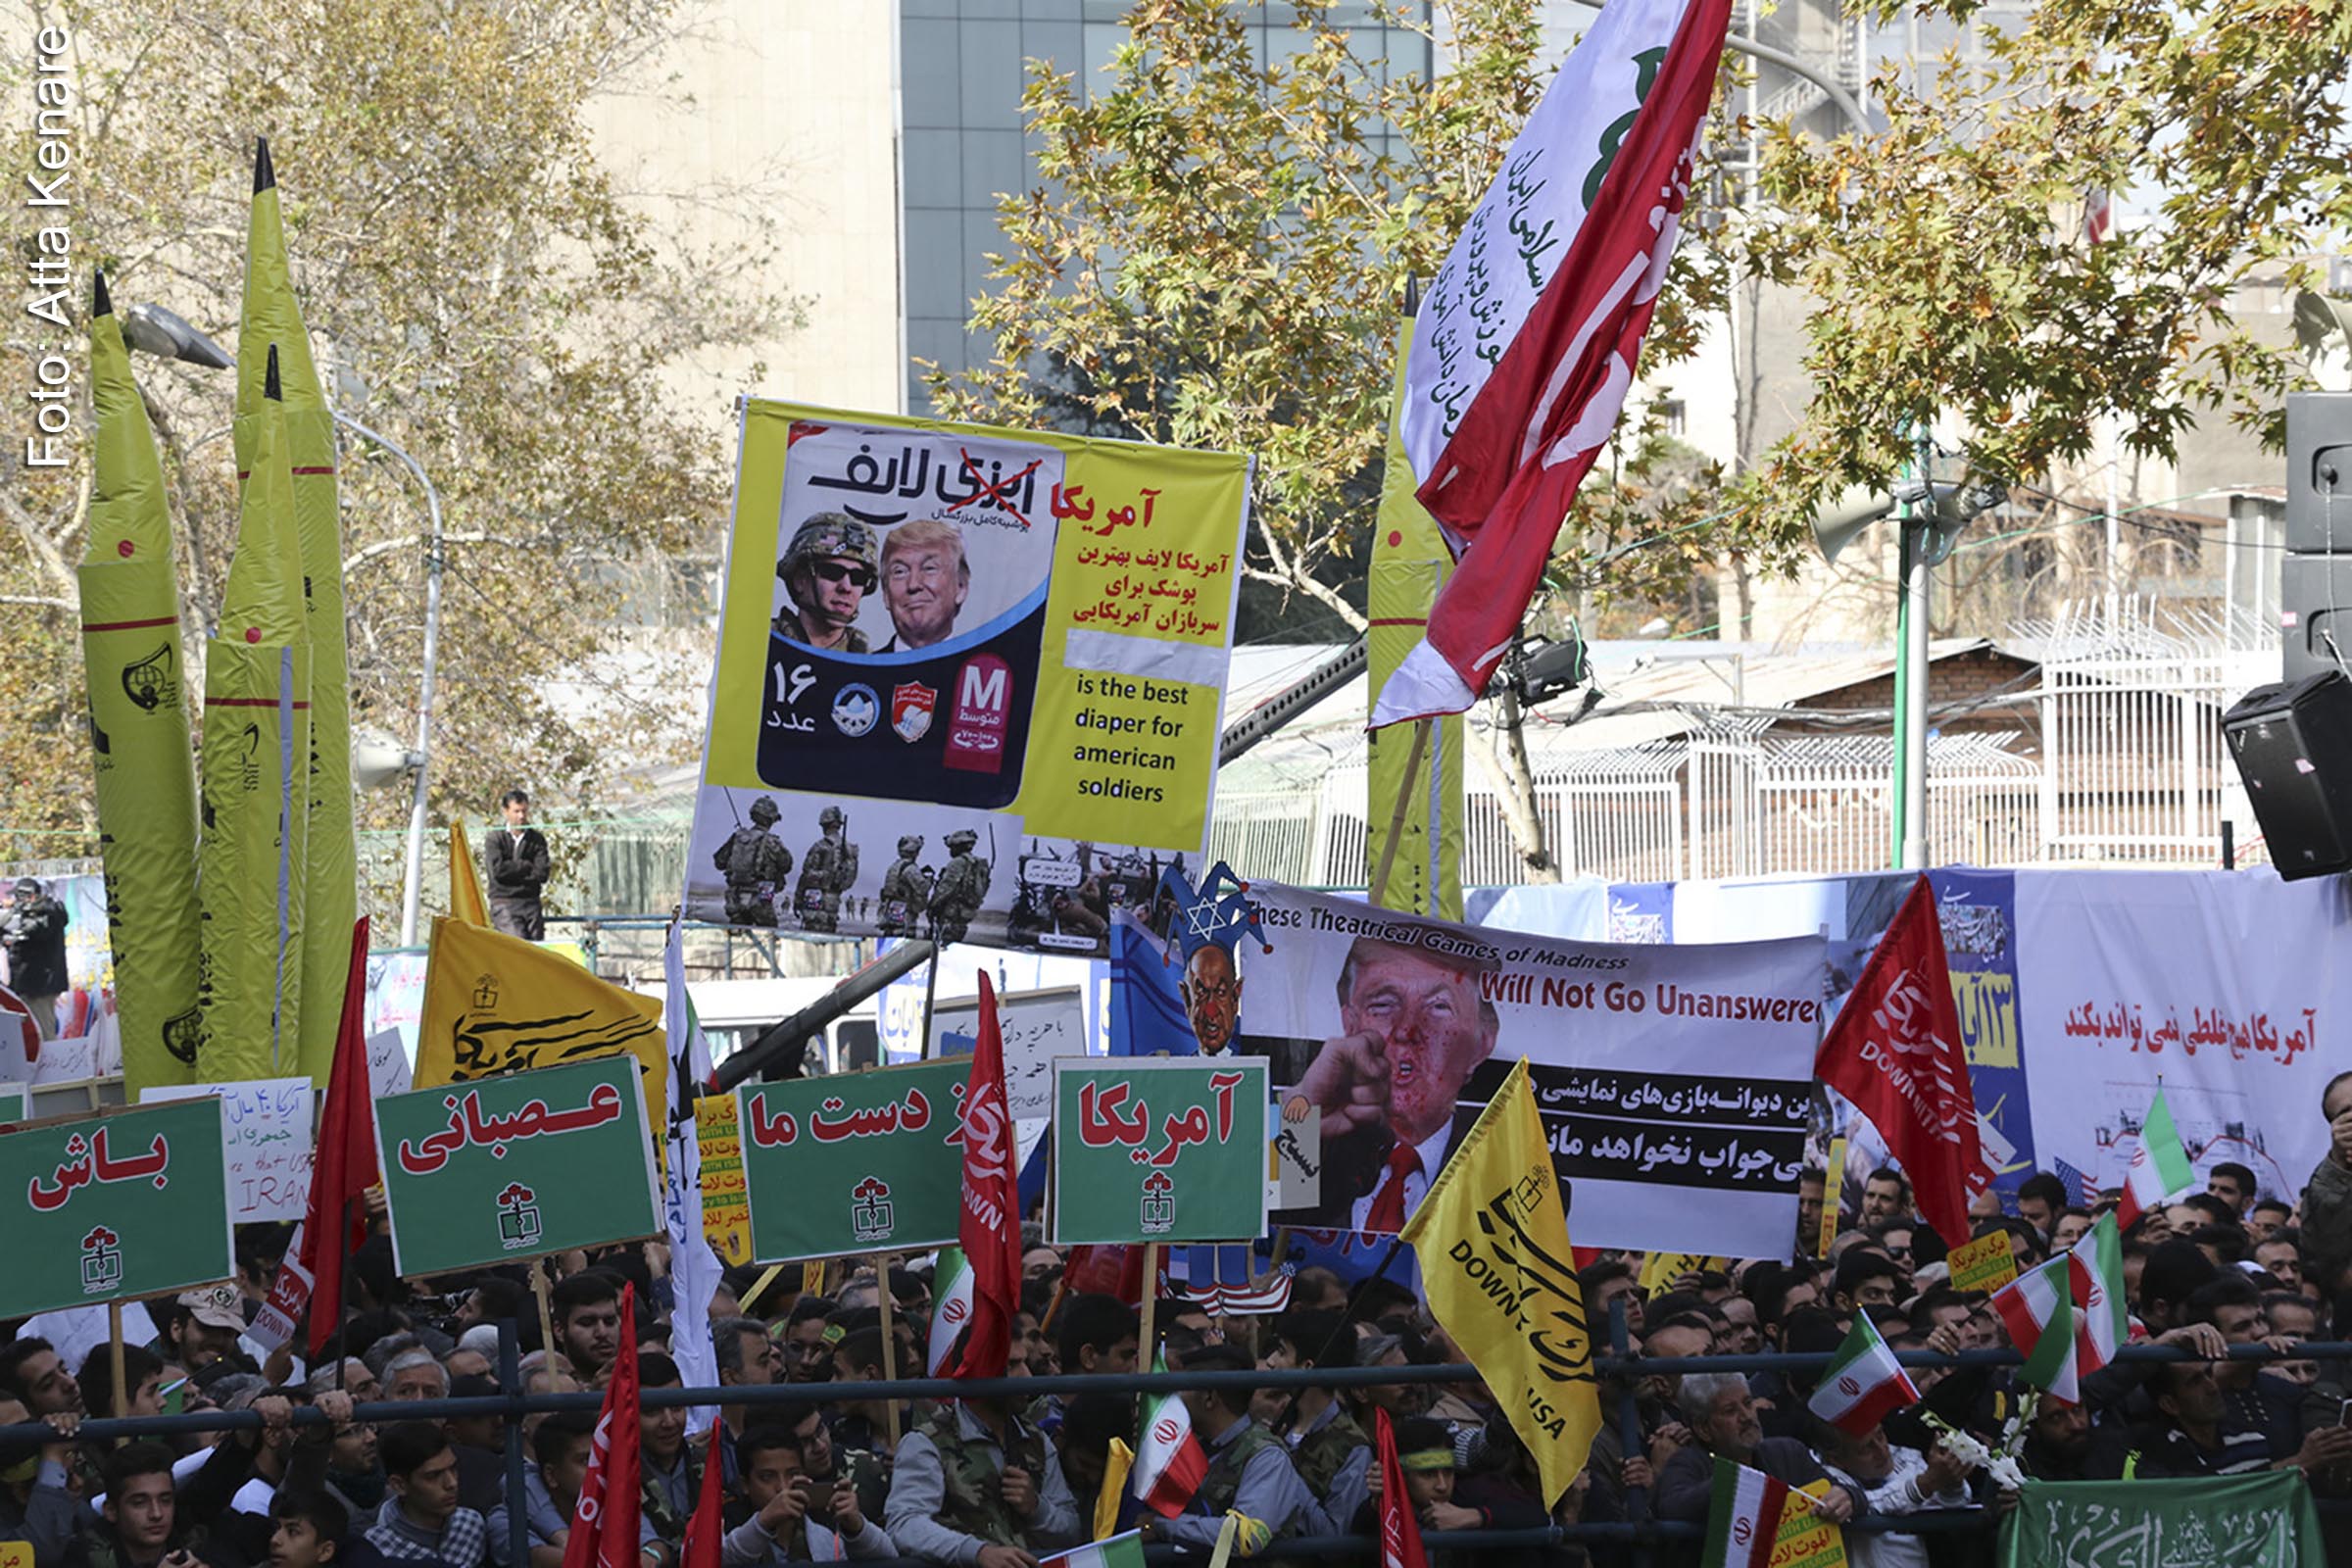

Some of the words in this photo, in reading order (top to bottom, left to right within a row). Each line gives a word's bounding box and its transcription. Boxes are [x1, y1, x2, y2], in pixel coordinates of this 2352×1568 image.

[1507, 148, 1548, 208] ایران
[808, 446, 931, 498] لایف
[1050, 481, 1162, 537] آمریکا
[1077, 546, 1132, 568] بهترین
[1135, 548, 1173, 572] لایف
[1176, 551, 1231, 578] آمریکا
[1104, 574, 1146, 600] برای
[1148, 578, 1198, 607] پوشک
[1073, 599, 1152, 628] آمریکایی
[1155, 609, 1220, 636] سربازان
[959, 665, 1007, 711] M
[1077, 673, 1094, 695] is
[1100, 676, 1138, 699] the
[1143, 680, 1189, 706] best
[766, 710, 815, 732] عدد
[958, 708, 1001, 727] متوسط
[1074, 707, 1147, 735] diaper
[1152, 714, 1184, 738] for
[1073, 745, 1176, 771] american
[1077, 776, 1164, 804] soldiers
[1310, 906, 1421, 944] Theatrical
[1422, 932, 1500, 961] Games
[1505, 945, 1533, 963] of
[1533, 951, 1631, 971] Madness
[1480, 970, 1534, 1005] Will
[1542, 977, 1595, 1009] Not
[1603, 981, 1647, 1014] Go
[1958, 973, 1984, 1062] آبا
[2064, 1001, 2103, 1048] بکند
[2104, 1001, 2143, 1053] تواند
[2145, 1004, 2181, 1054] نمی
[2182, 1005, 2229, 1056] غلطی
[2250, 1007, 2318, 1066] آمریکا
[1541, 1076, 1618, 1105] نمایشی
[1858, 1039, 1916, 1101] DOWN
[398, 1082, 623, 1176] عصبانی
[748, 1091, 799, 1149] ما
[810, 1087, 931, 1144] دست
[1079, 1070, 1245, 1167] آمریکا
[1546, 1123, 1585, 1156] مان
[1591, 1134, 1692, 1172] نخواهد
[27, 1126, 171, 1213] باش
[1447, 1238, 1522, 1320] DOWN
